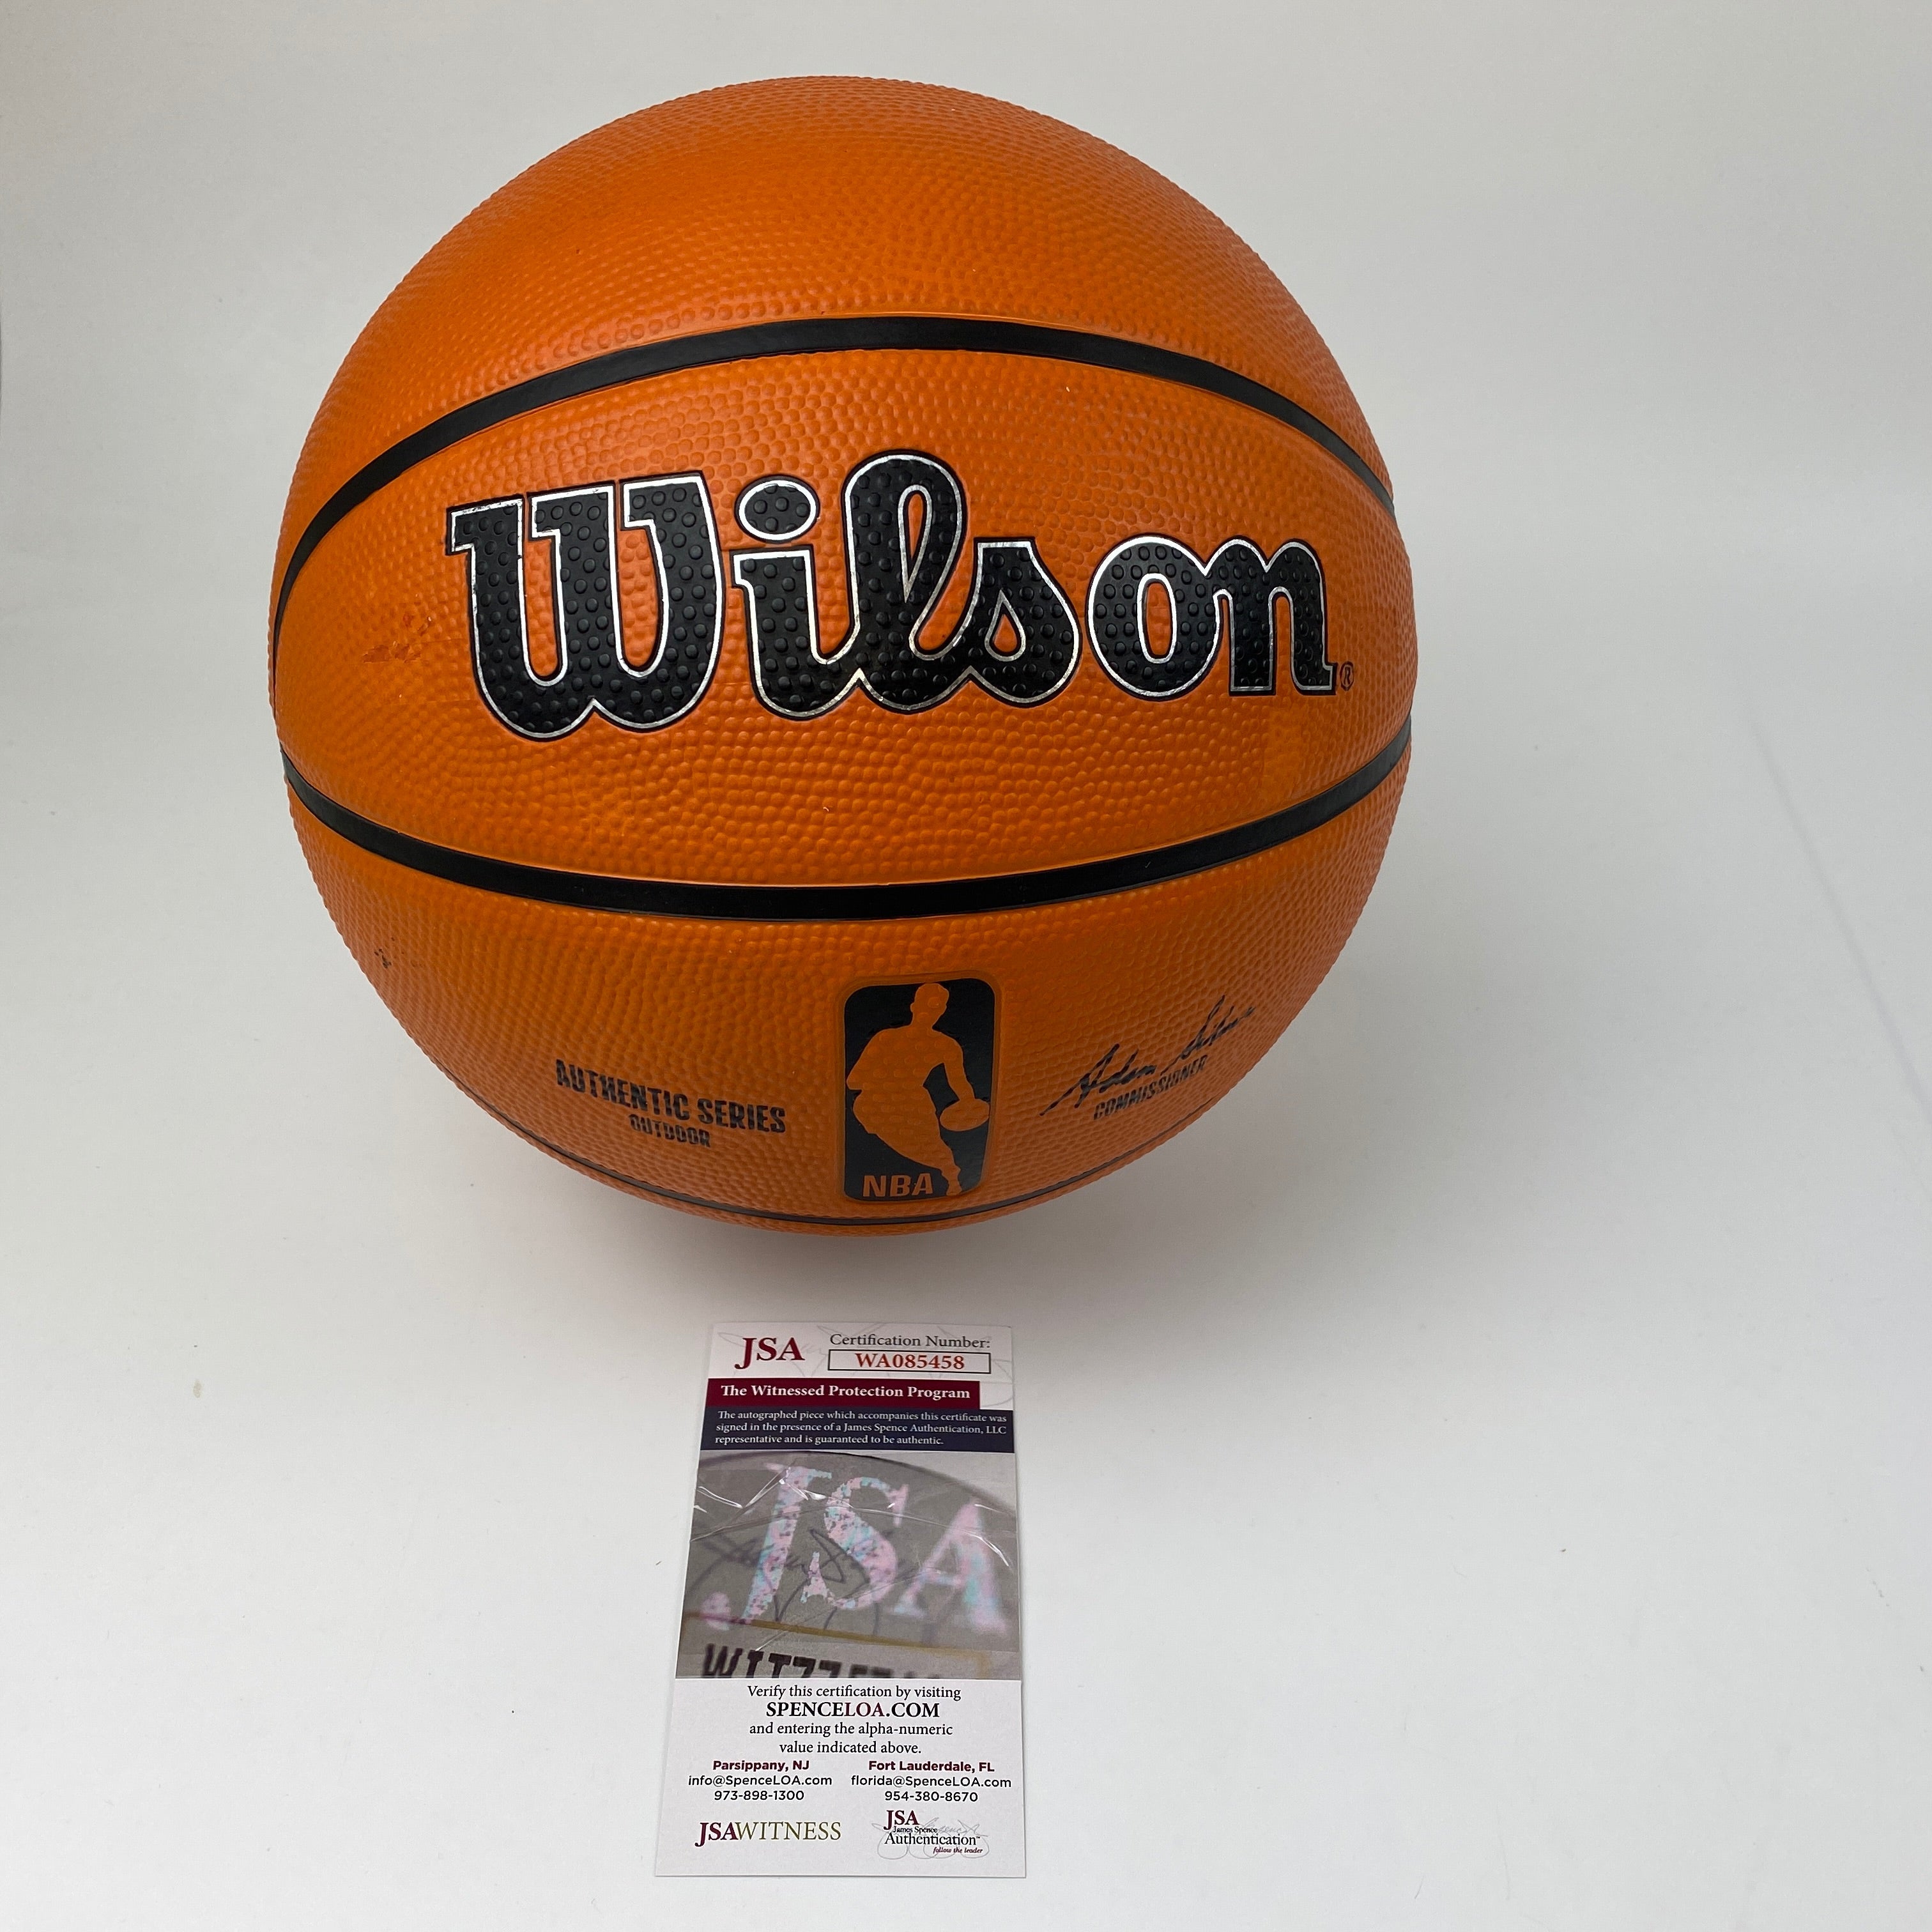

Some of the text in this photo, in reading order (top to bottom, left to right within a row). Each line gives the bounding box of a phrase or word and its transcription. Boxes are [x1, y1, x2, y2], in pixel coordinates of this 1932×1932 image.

[1093, 1054, 1209, 1120] COMMISSIONER
[555, 1059, 786, 1133] AUTHENTIC SERIES
[628, 1114, 711, 1147] OUTDOOR
[863, 1172, 933, 1197] NBA
[830, 1333, 991, 1348] Certification Number:
[734, 1337, 806, 1370] JSA
[854, 1353, 965, 1370] WA085458
[721, 1384, 970, 1401] The Witnessed Protection Program
[717, 1410, 735, 1420] The
[737, 1410, 797, 1422] autographed
[799, 1411, 825, 1422] piece
[827, 1411, 855, 1420] which
[857, 1411, 919, 1422] accompanies
[921, 1411, 939, 1421] this
[940, 1412, 987, 1422] certificate
[716, 1422, 747, 1434] signed
[750, 1422, 760, 1431] in
[762, 1422, 778, 1431] the
[779, 1423, 822, 1433] presence
[824, 1422, 836, 1431] of
[843, 1422, 872, 1432] James
[874, 1423, 908, 1434] Spence
[909, 1423, 985, 1435] Authentication,
[986, 1425, 1007, 1435] LLC
[715, 1434, 944, 1446] representative and is guaranteed to be authentic.
[703, 1462, 1008, 1636] JSA
[747, 1684, 962, 1701] Verify this certification by visiting
[766, 1701, 940, 1718] SPENCELOA.COM
[749, 1721, 953, 1738] and entering the alpha-numeric
[779, 1740, 921, 1754] value indicated above.
[712, 1759, 810, 1772] Parsippany, NJ
[868, 1760, 995, 1774] Fort Lauderdale, FL
[688, 1775, 832, 1788] info@SpenceLOA.com
[851, 1775, 1012, 1788] florida@SpenceLOA.com
[714, 1790, 805, 1801] 973-898-1300
[884, 1791, 979, 1802] 954-380-8670
[883, 1809, 920, 1831] JSA
[914, 1825, 938, 1834] Spence
